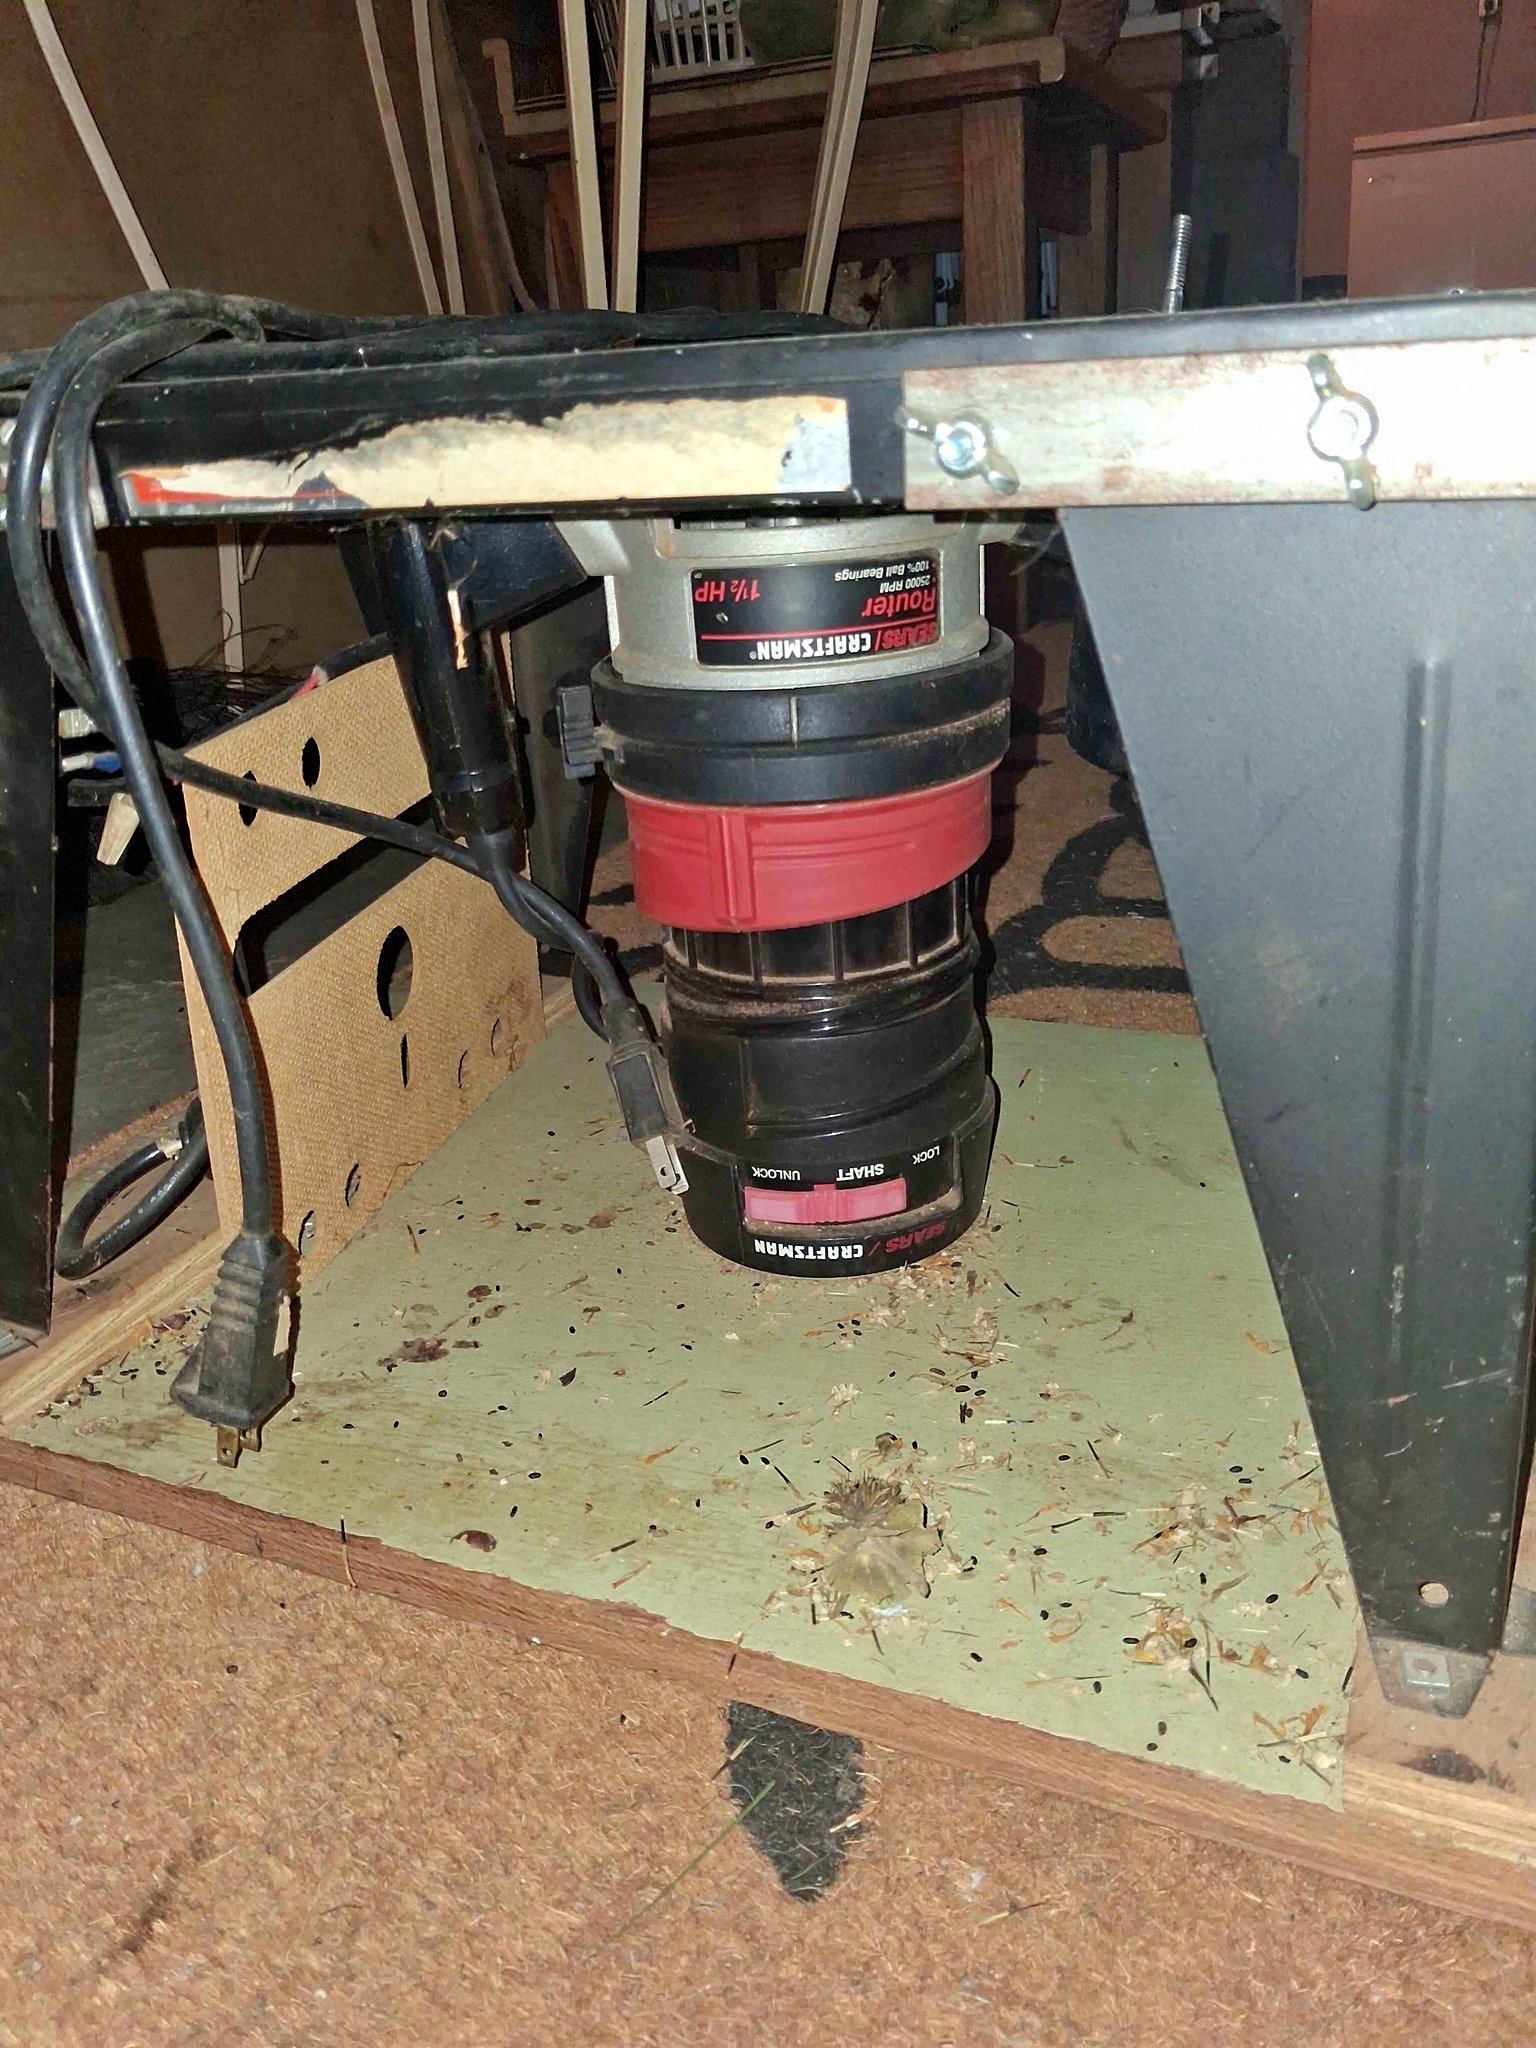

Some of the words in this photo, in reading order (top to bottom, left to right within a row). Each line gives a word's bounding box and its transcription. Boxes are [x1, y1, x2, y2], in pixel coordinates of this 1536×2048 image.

[885, 563, 904, 577] Ball
[907, 560, 930, 573] 100%
[834, 567, 881, 582] Bearings
[905, 574, 931, 589] 25000
[694, 580, 726, 603] HP
[879, 581, 904, 593] RPM
[861, 589, 937, 618] Router
[912, 1145, 940, 1165] LOCK
[751, 1166, 801, 1181] UNLOCK
[835, 1163, 884, 1182] SHAFT
[754, 1238, 864, 1260] CRAFTSMAN
